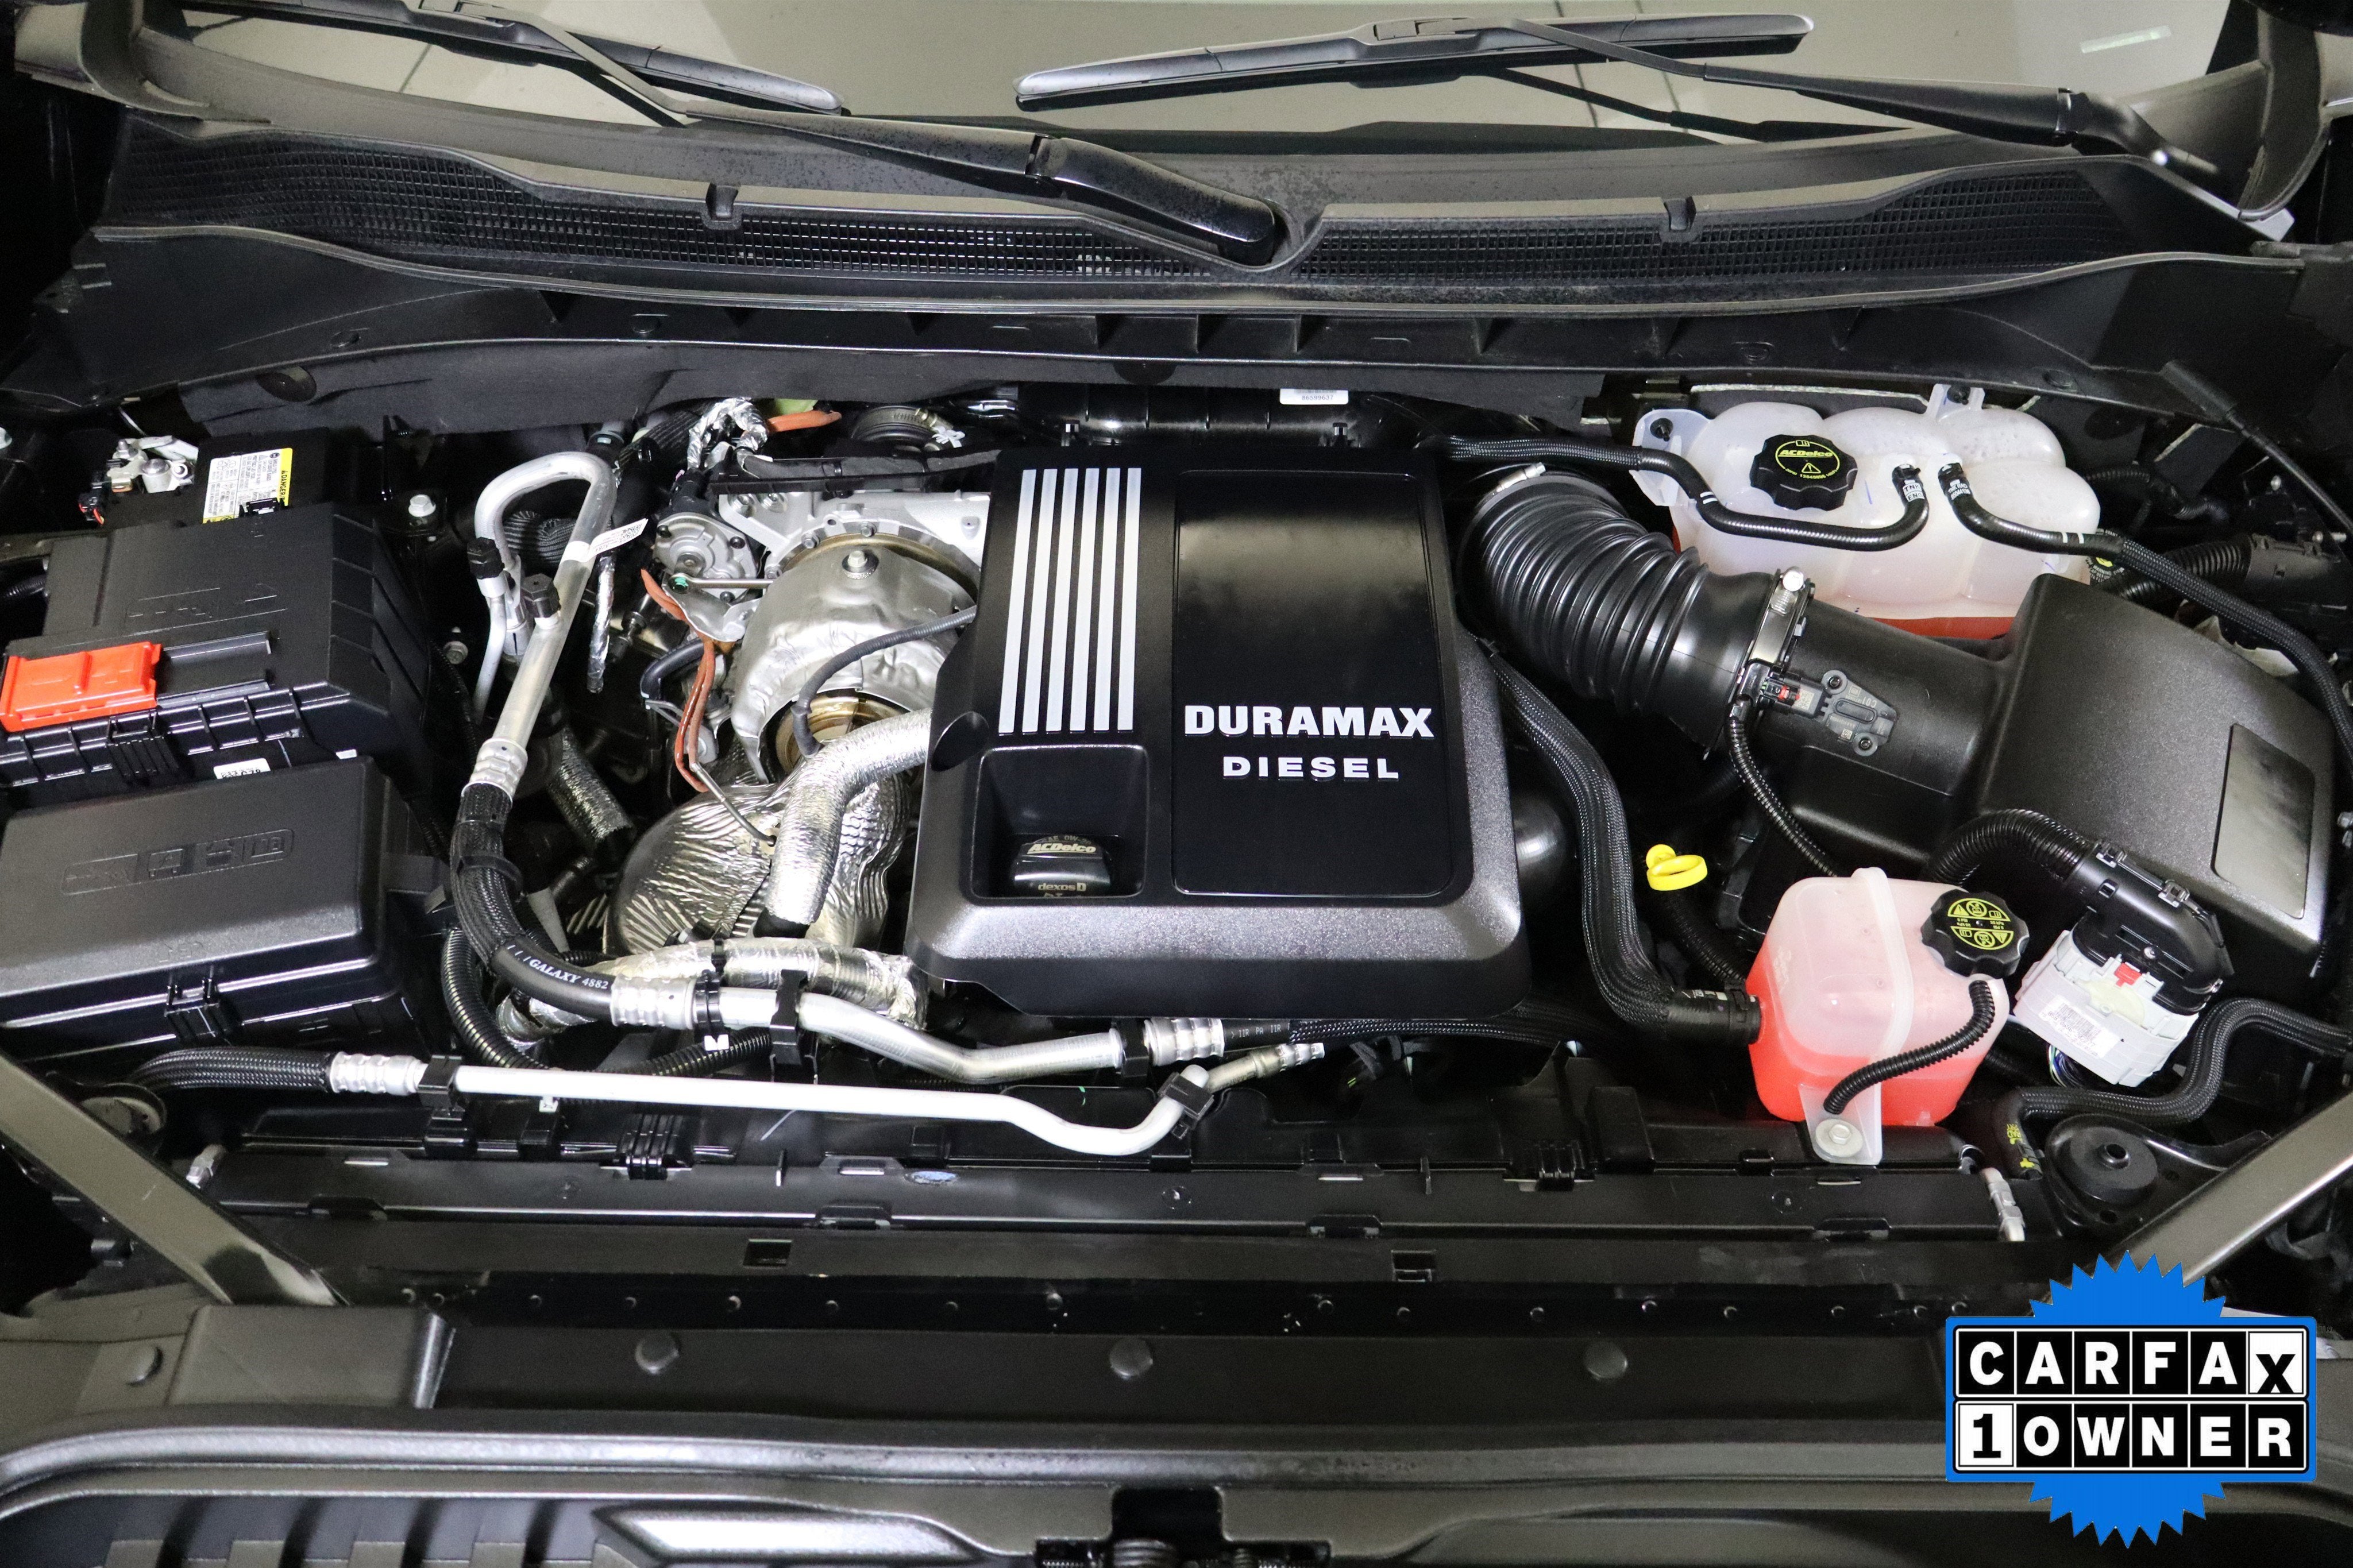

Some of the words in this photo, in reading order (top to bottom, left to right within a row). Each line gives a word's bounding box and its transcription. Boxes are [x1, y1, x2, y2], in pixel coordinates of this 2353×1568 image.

[1185, 705, 1435, 739] DURAMAX
[1222, 756, 1399, 781] DIESEL
[1027, 843, 1097, 854] ACDelco
[529, 959, 582, 984] GALAXY
[582, 978, 609, 990] 4882
